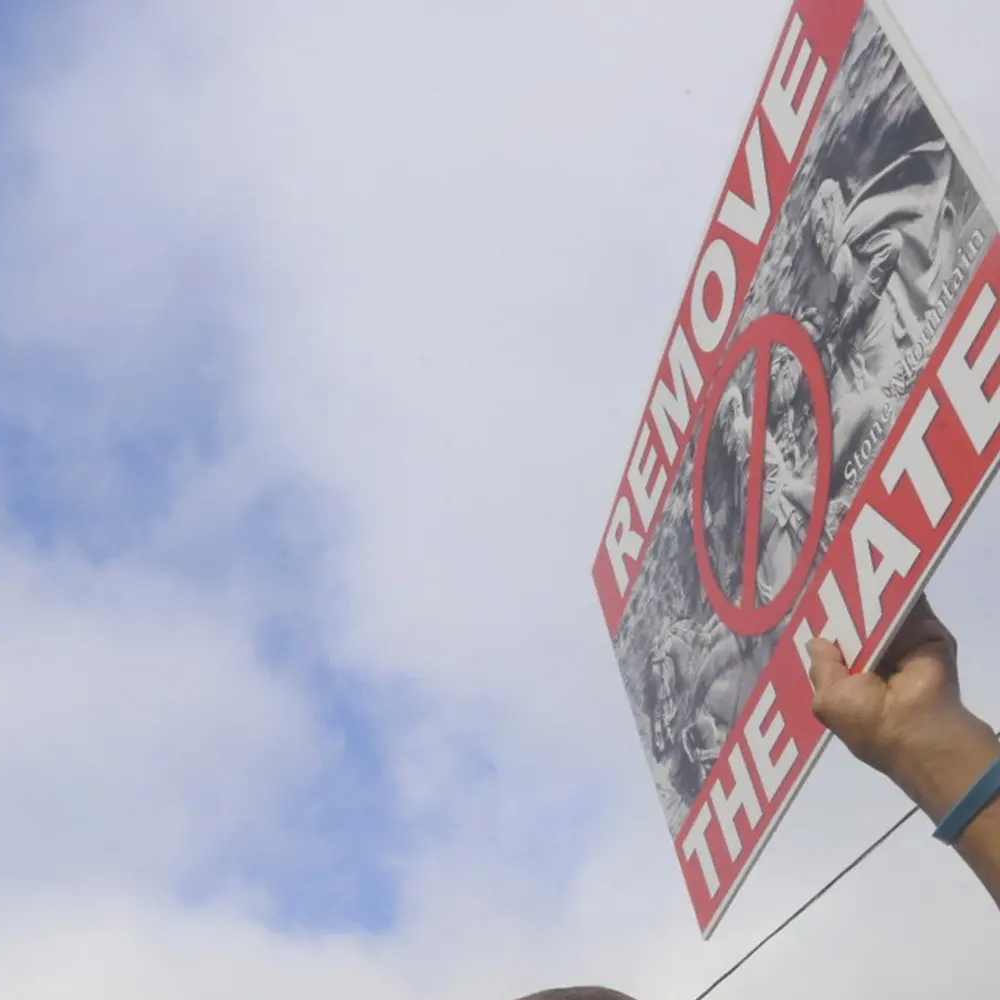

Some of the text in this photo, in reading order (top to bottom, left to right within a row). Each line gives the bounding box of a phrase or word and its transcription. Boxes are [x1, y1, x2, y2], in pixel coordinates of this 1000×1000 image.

[605, 12, 827, 598] REMOVE
[682, 282, 1000, 899] THE HATE
[844, 228, 986, 486] Stone Mountain
